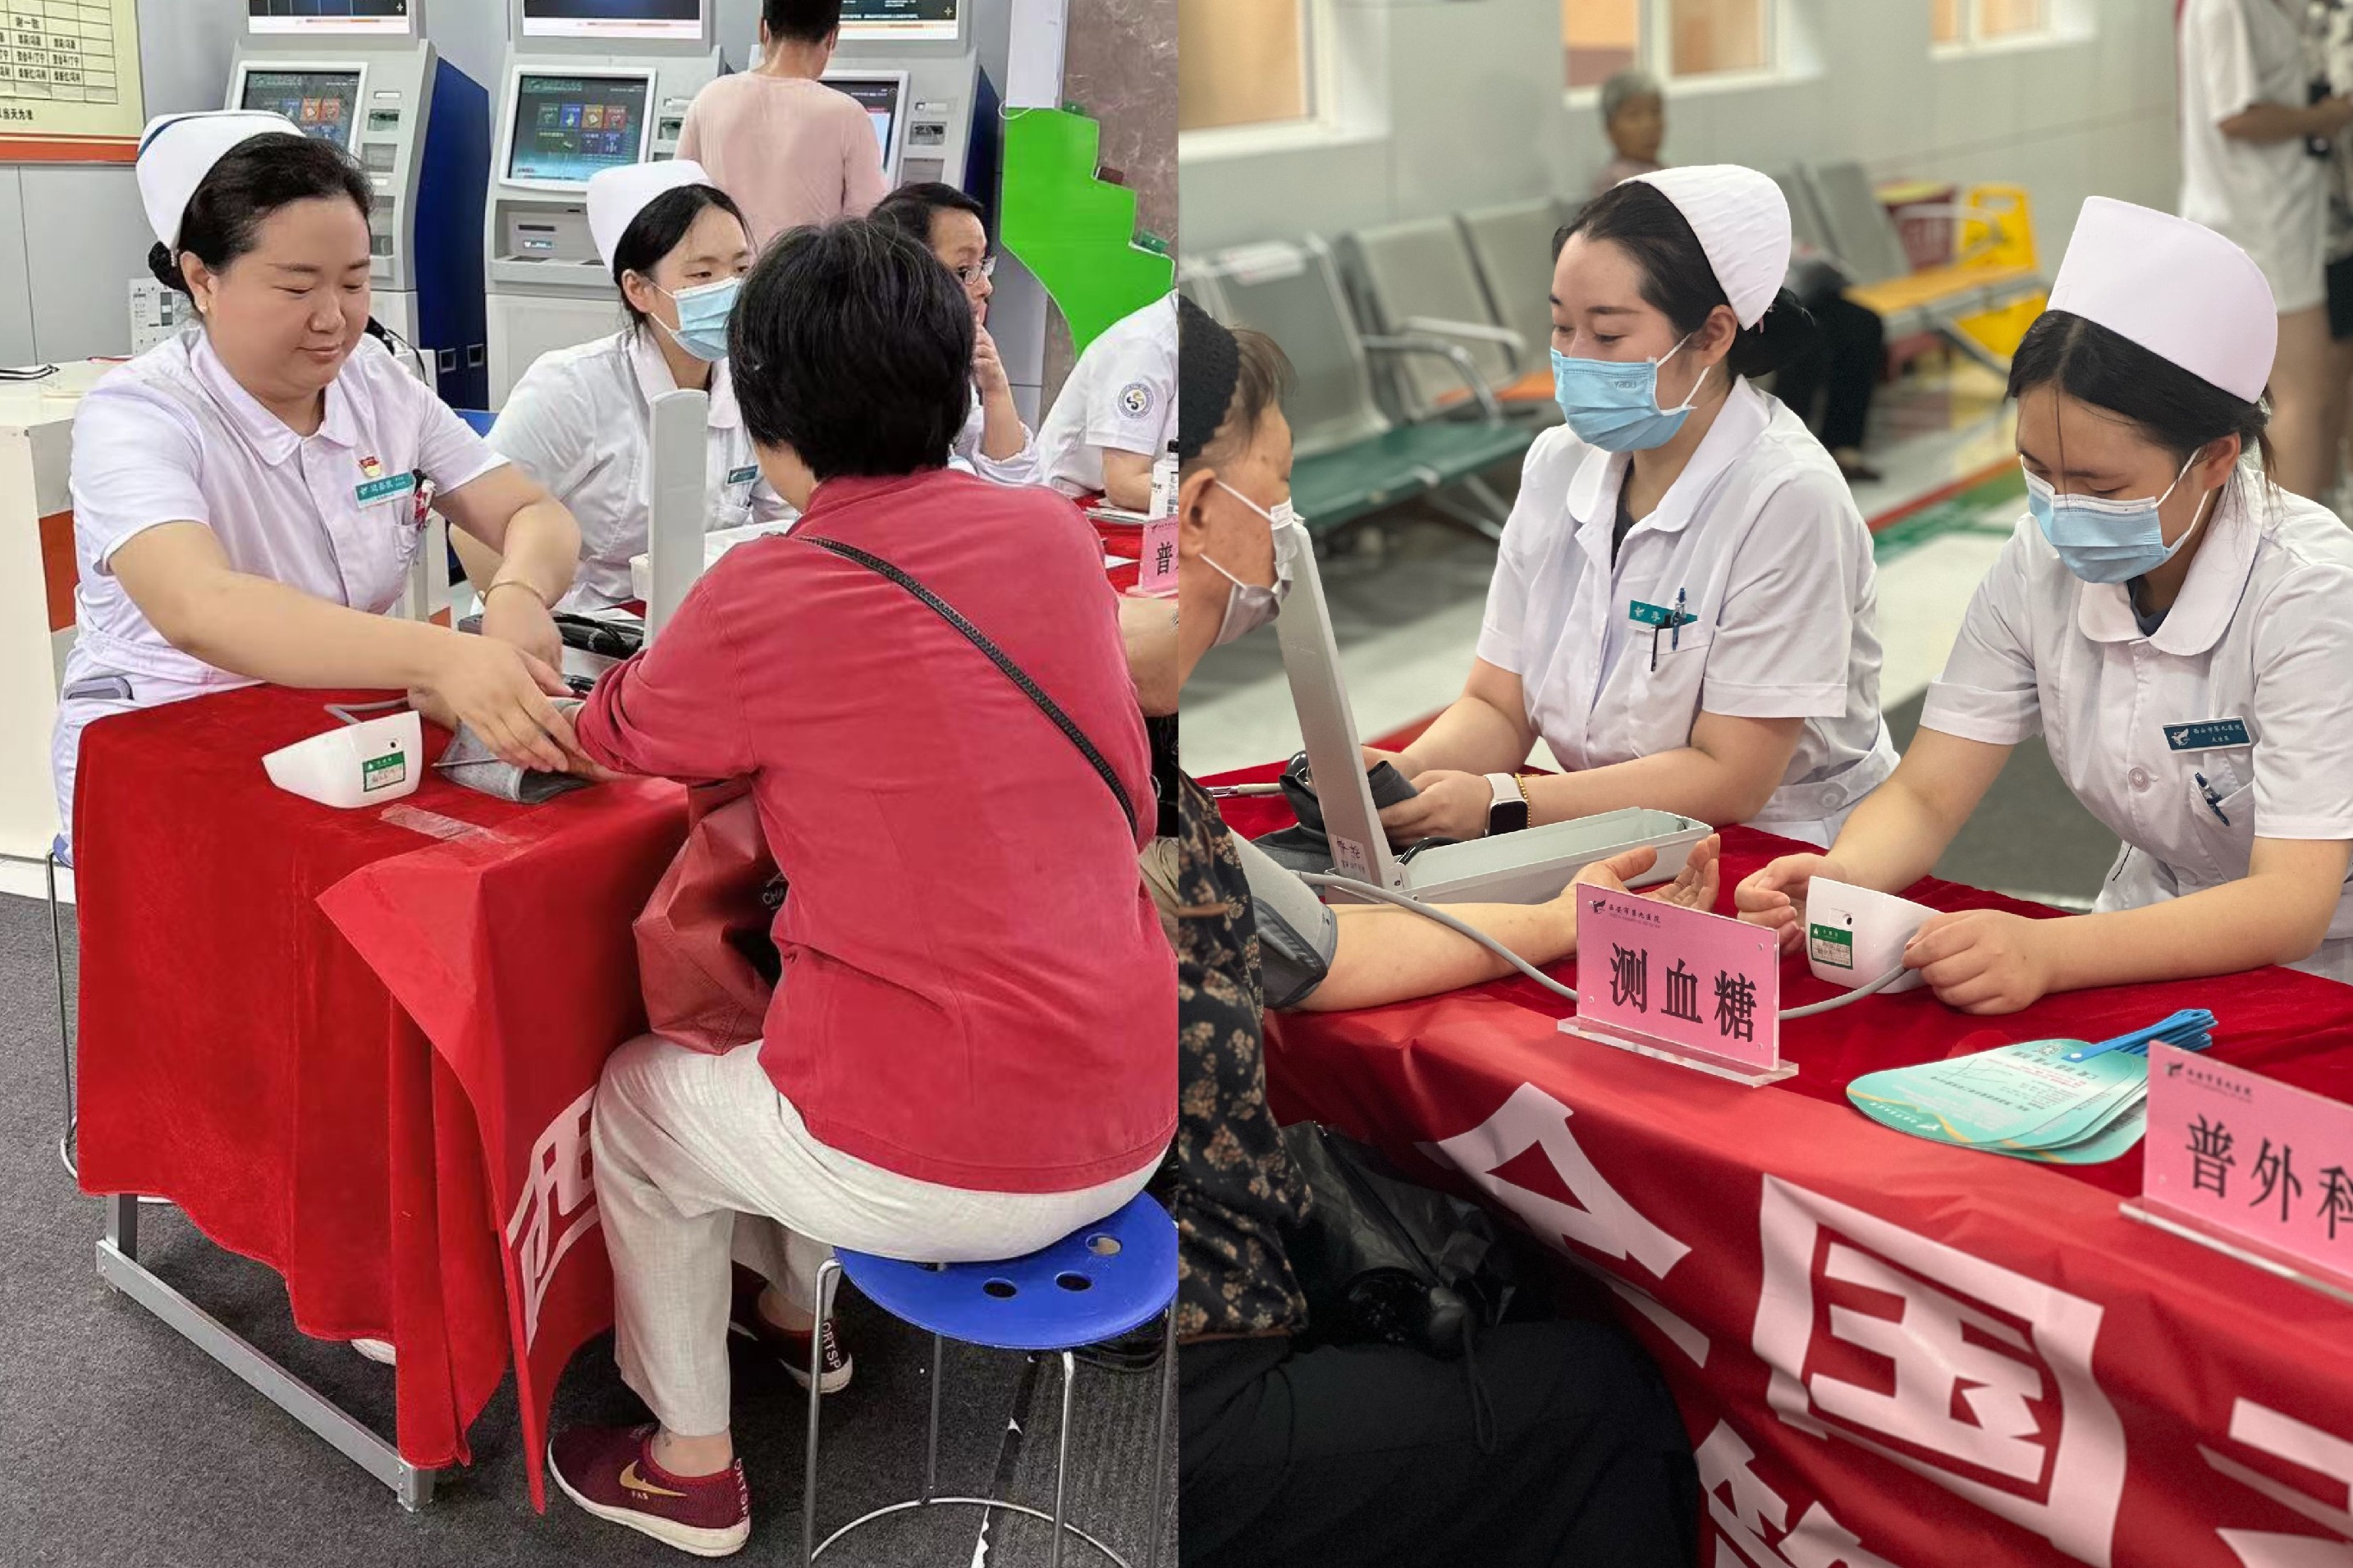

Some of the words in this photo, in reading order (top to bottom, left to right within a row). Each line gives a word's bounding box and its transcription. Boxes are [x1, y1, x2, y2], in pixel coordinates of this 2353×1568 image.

[1156, 542, 1179, 576] 普
[1609, 942, 1756, 1043] 测血糖
[2186, 1113, 2353, 1240] 普外科
